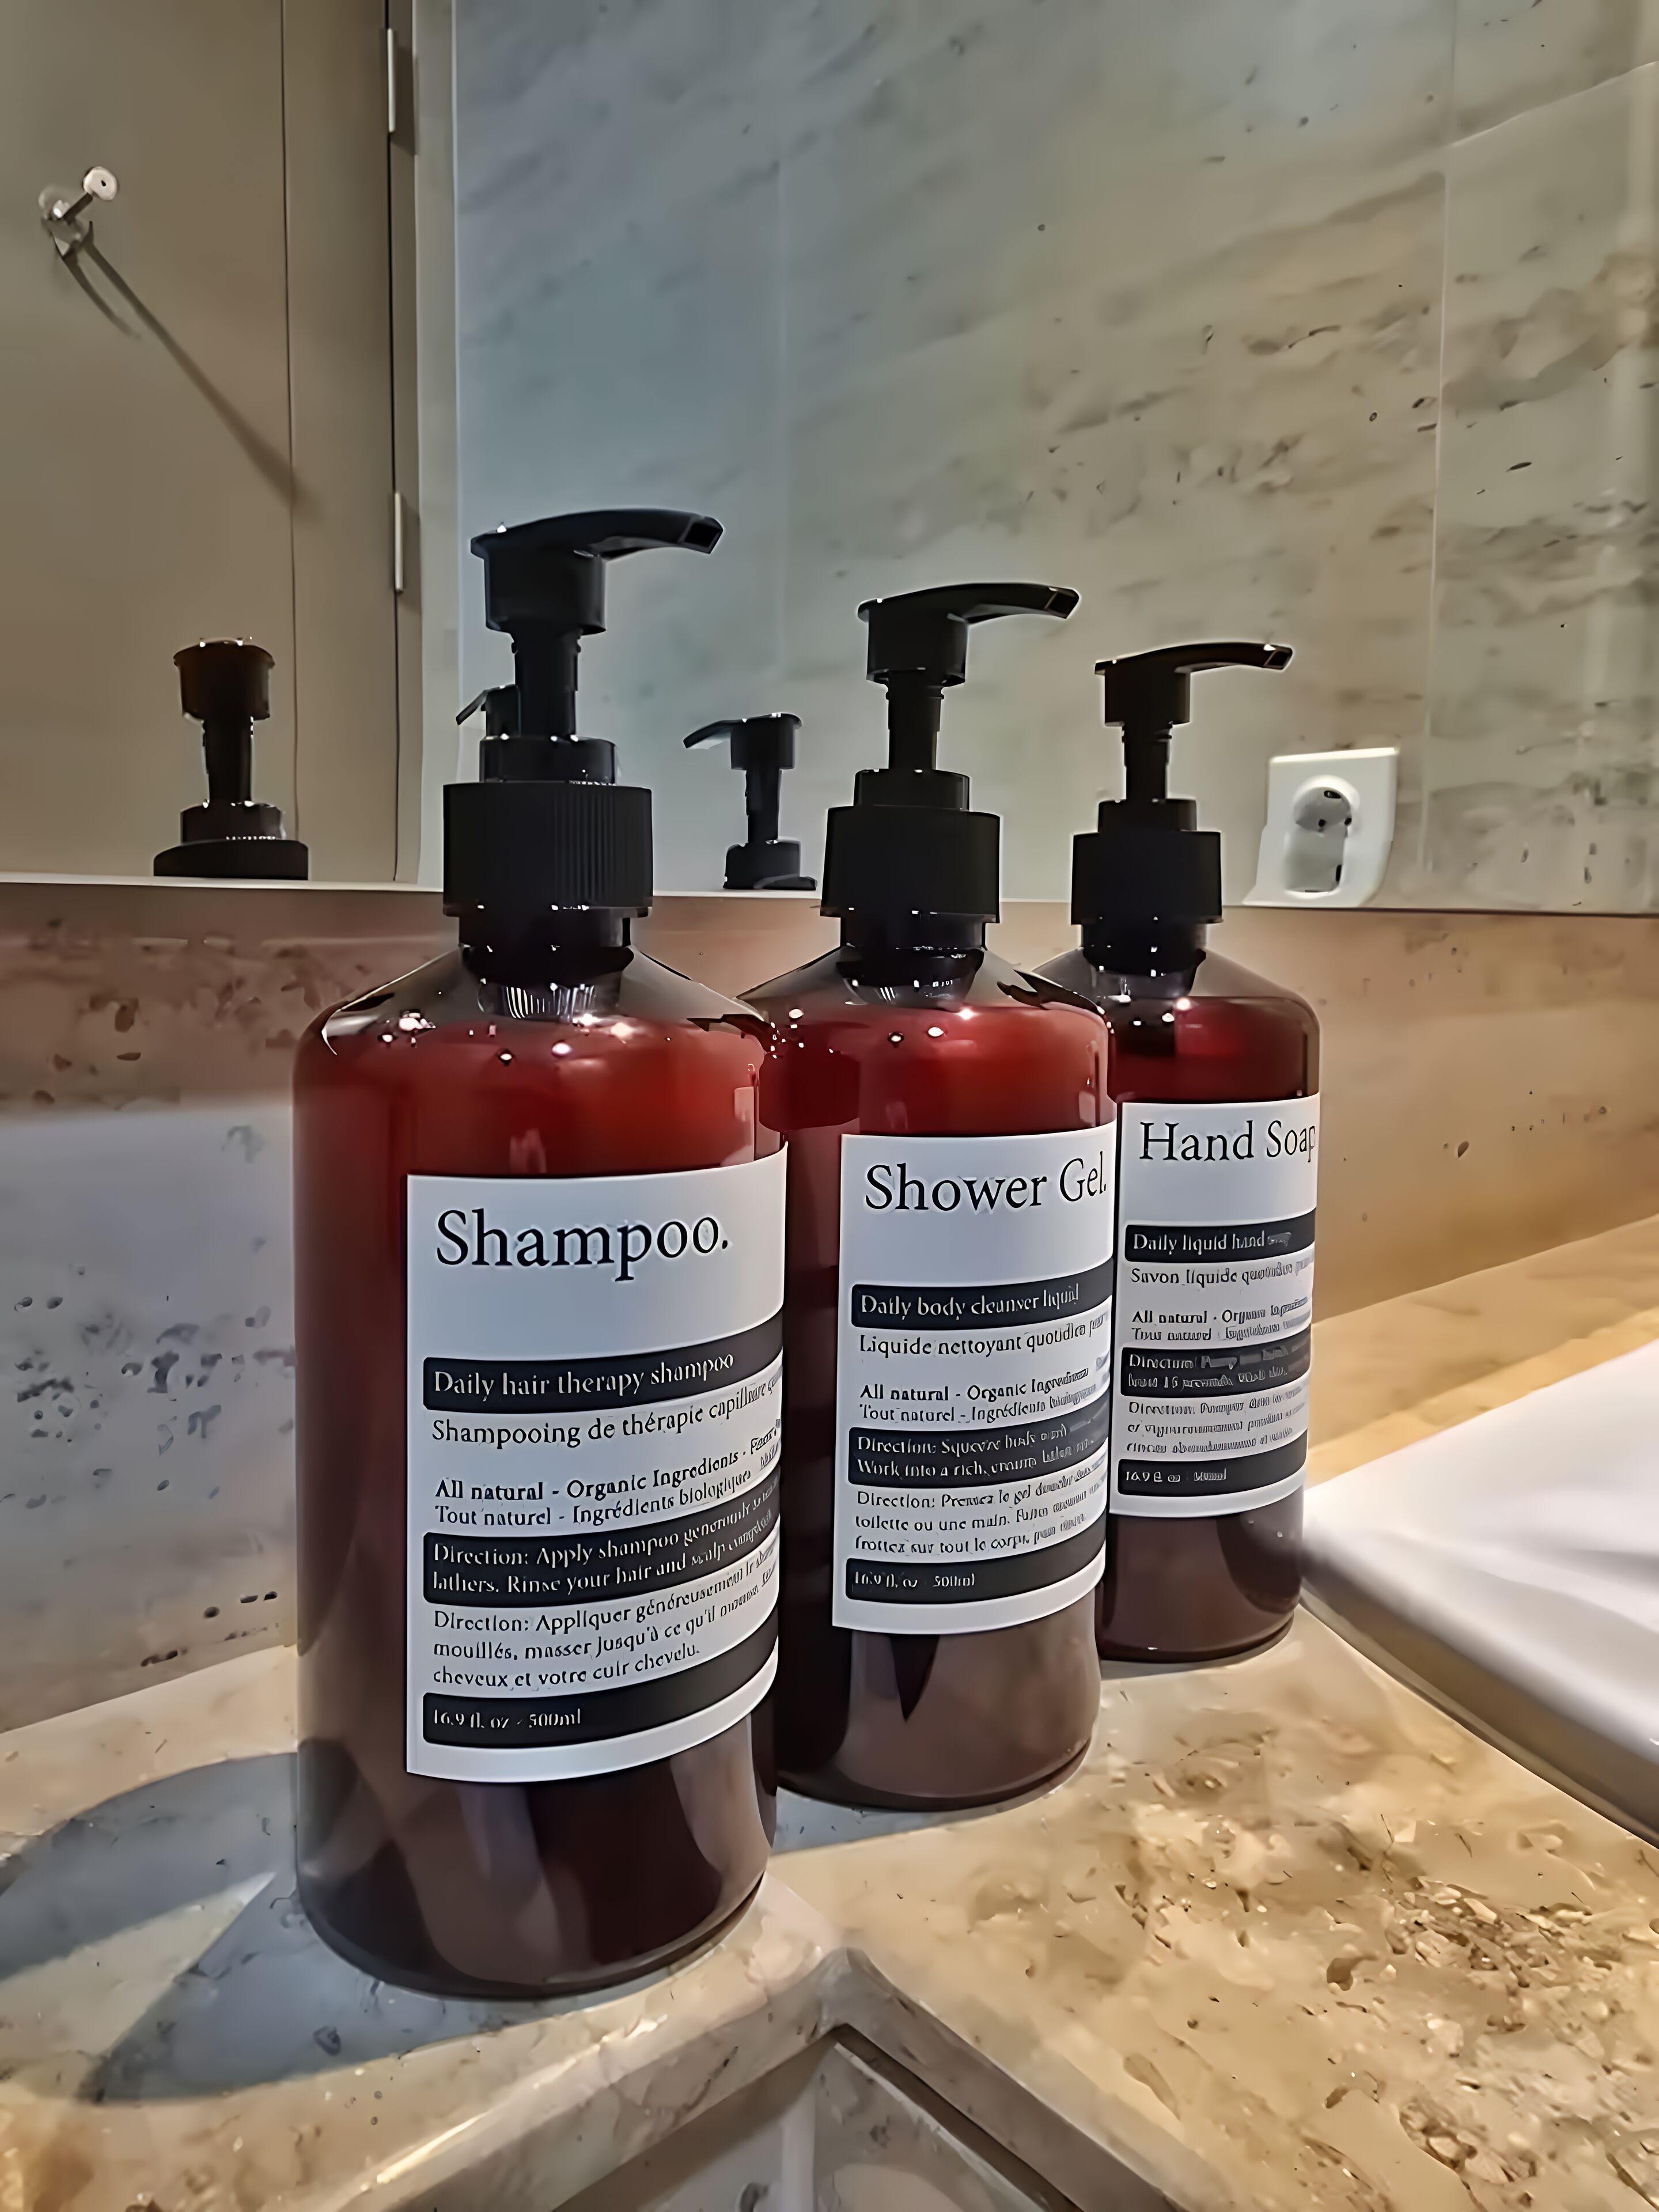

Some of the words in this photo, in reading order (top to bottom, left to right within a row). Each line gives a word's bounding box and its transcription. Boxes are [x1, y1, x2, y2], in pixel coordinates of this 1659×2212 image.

[1139, 1120, 1254, 1161] Hand
[865, 1162, 1047, 1211] Shower
[437, 1208, 728, 1282] Shampoo.
[1134, 1234, 1177, 1255] Daily
[1183, 1234, 1227, 1255] liquid
[1131, 1268, 1179, 1283] Savon
[1186, 1268, 1237, 1288] liquide
[861, 1295, 911, 1320] Daily
[918, 1297, 966, 1320] body
[1132, 1310, 1153, 1323] All
[860, 1335, 931, 1358] Liquide
[938, 1336, 1022, 1357] nettoyant
[434, 1371, 494, 1401] Daily
[502, 1373, 550, 1394] hair
[558, 1370, 644, 1396] therapy
[651, 1354, 734, 1385] shampoo
[860, 1384, 884, 1399] All
[891, 1385, 949, 1401] natural
[967, 1383, 1026, 1402] Organic
[860, 1404, 895, 1421] Tout
[901, 1406, 955, 1422] naturel
[432, 1420, 581, 1449] Shampooing
[588, 1418, 615, 1439] de
[623, 1404, 703, 1435] thérapie
[858, 1459, 899, 1476] Work
[435, 1480, 461, 1498] All
[472, 1482, 543, 1501] natural
[567, 1476, 646, 1499] Organic
[435, 1506, 477, 1524] Tout
[484, 1508, 551, 1526] naturel
[914, 1520, 933, 1532] ou
[938, 1520, 966, 1531] une
[435, 1543, 528, 1567] Direction:
[537, 1542, 593, 1569] Apply
[599, 1533, 679, 1560] shampoo
[507, 1575, 560, 1593] Rinse
[567, 1573, 609, 1595] your
[616, 1565, 652, 1585] hair
[656, 1552, 685, 1576] and
[435, 1611, 529, 1633] Direction:
[536, 1609, 631, 1635] Appliquer
[525, 1641, 592, 1660] masser
[664, 1623, 681, 1638] ce
[434, 1668, 508, 1687] cheveux
[514, 1672, 531, 1687] et
[539, 1669, 586, 1686] votre
[593, 1661, 630, 1680] cuir
[635, 1644, 700, 1673] chevelu.
[529, 1708, 581, 1727] 500ml
